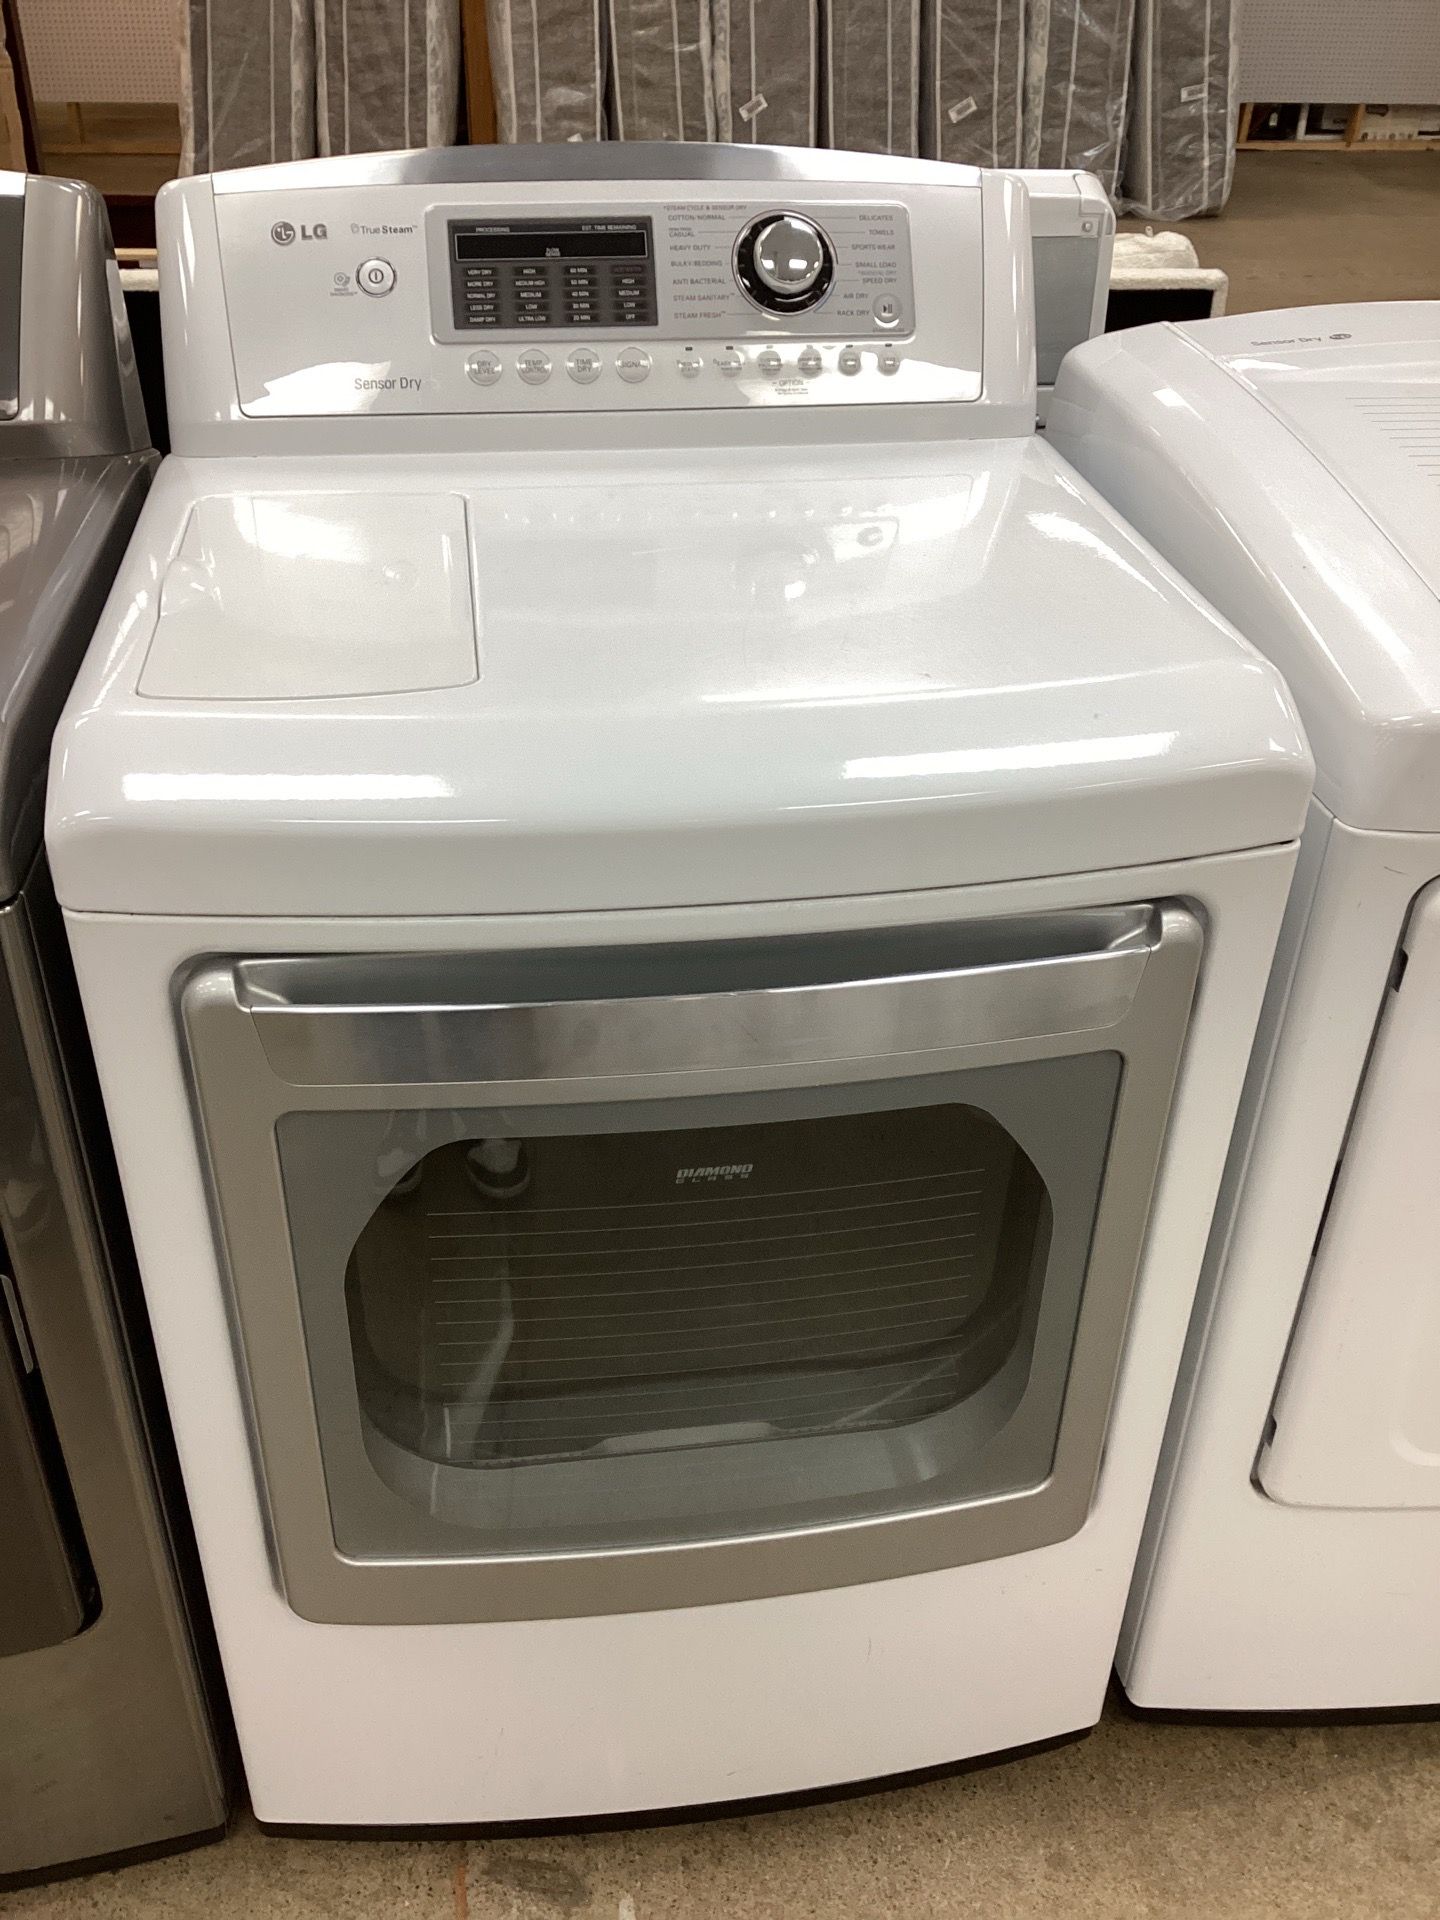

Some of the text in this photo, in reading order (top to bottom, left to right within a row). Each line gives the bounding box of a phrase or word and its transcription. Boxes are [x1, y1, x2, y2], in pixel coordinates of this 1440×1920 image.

[301, 223, 328, 241] LG
[577, 365, 592, 373] DRY
[354, 377, 422, 391] Sensor Dry
[676, 1164, 753, 1178] DIAMOND
